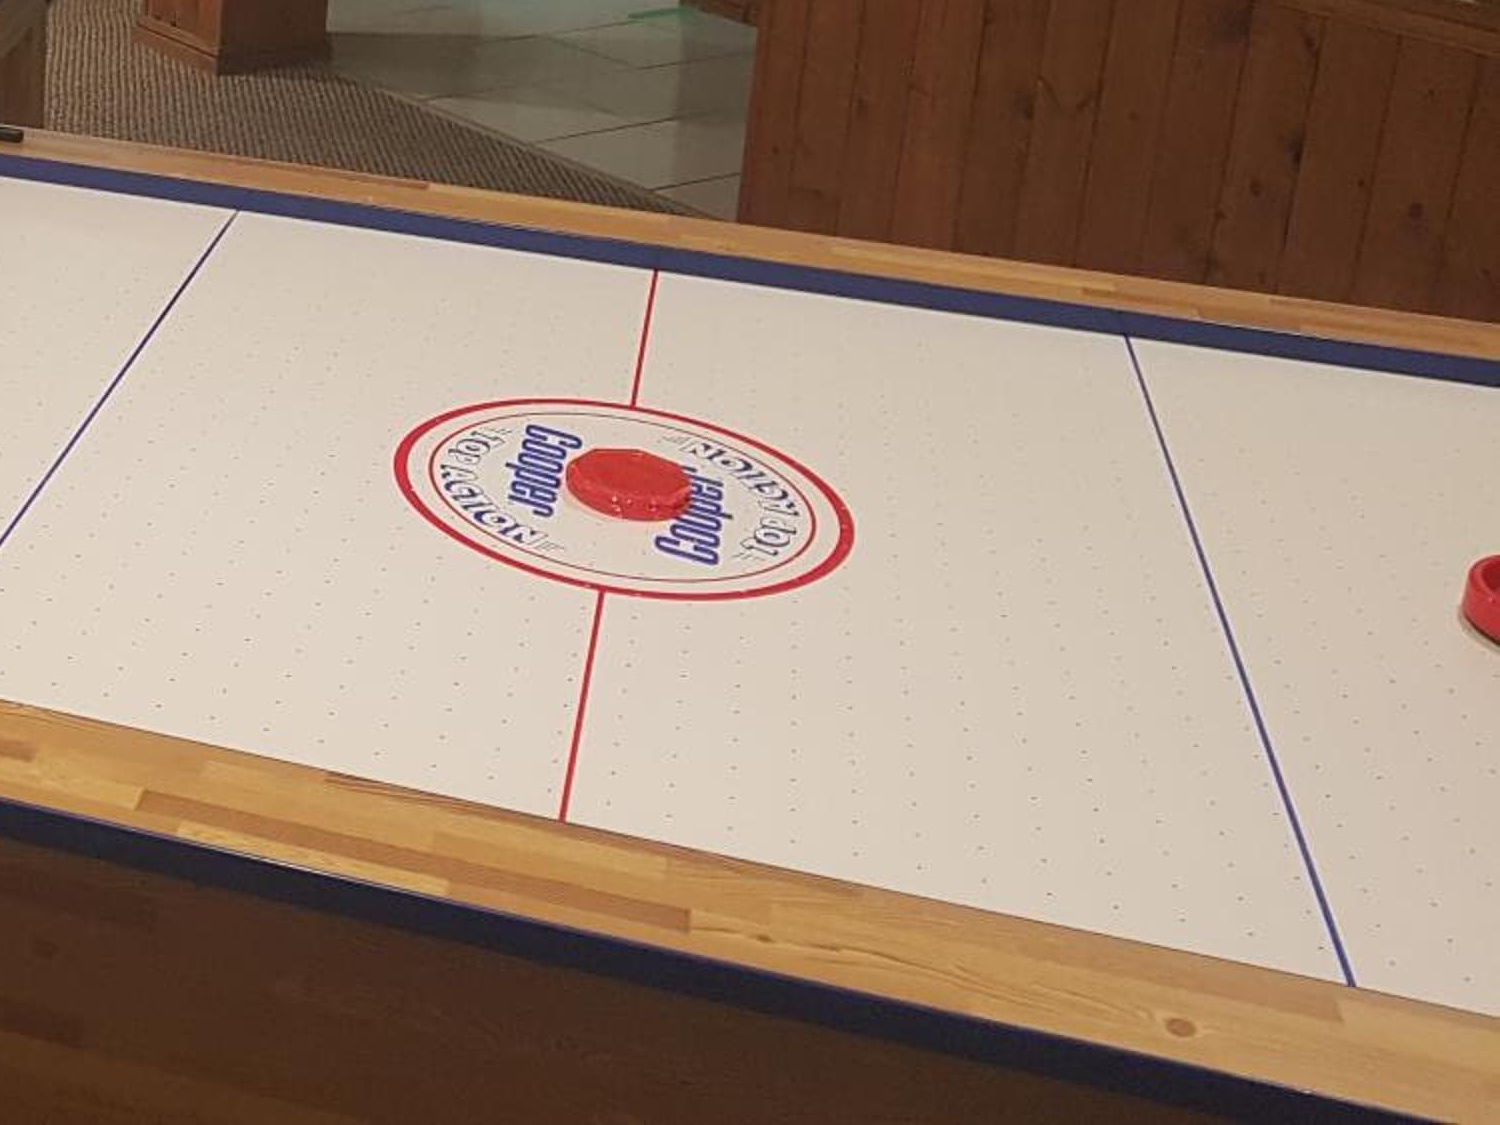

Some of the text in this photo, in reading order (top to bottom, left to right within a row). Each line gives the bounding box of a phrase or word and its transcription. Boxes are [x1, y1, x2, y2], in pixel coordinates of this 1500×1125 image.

[440, 430, 547, 546] TOP ACTION
[505, 424, 583, 518] Cooper
[679, 441, 799, 557] TOP ACTION
